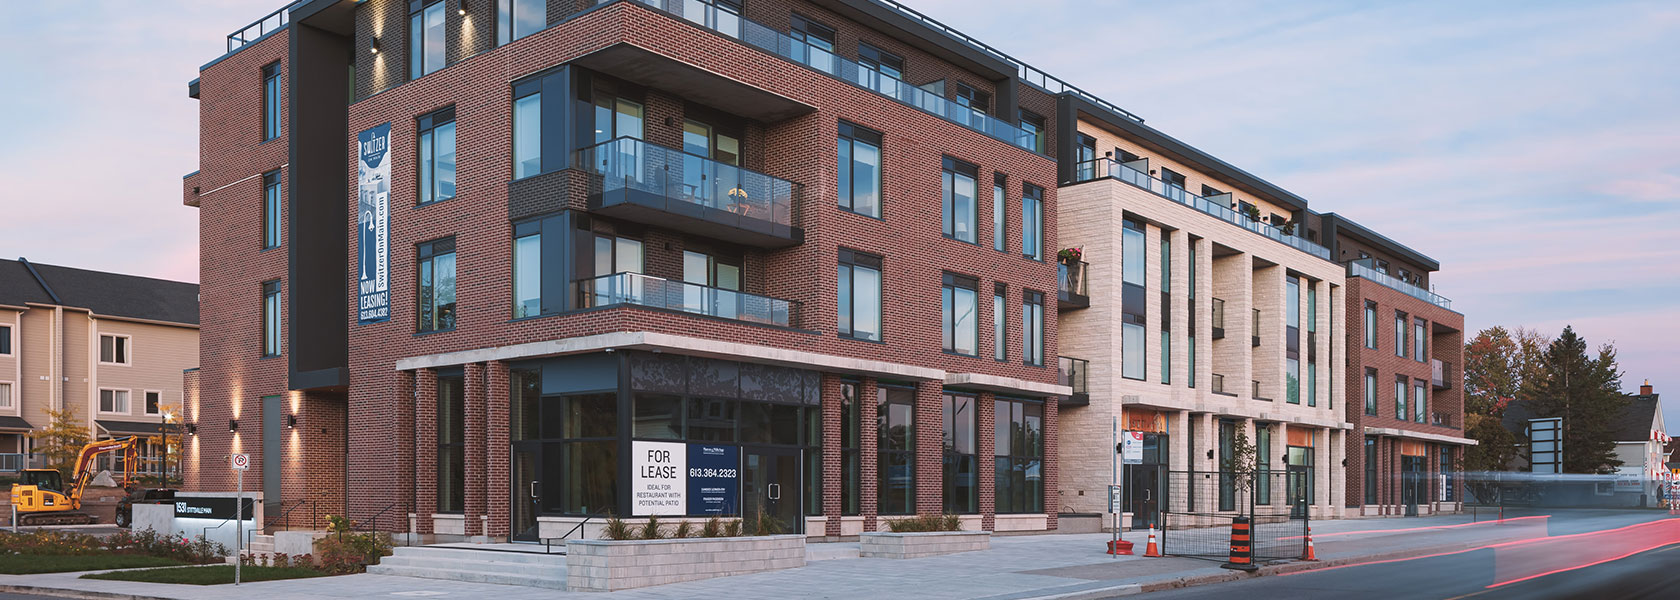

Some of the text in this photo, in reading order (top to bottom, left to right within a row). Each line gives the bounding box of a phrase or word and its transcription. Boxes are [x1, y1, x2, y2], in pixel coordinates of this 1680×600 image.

[361, 280, 375, 295] NOW
[361, 291, 388, 310] LEASING!
[648, 450, 670, 463] FOR
[641, 466, 677, 479] LEASE
[689, 468, 737, 478] 613.364.2323
